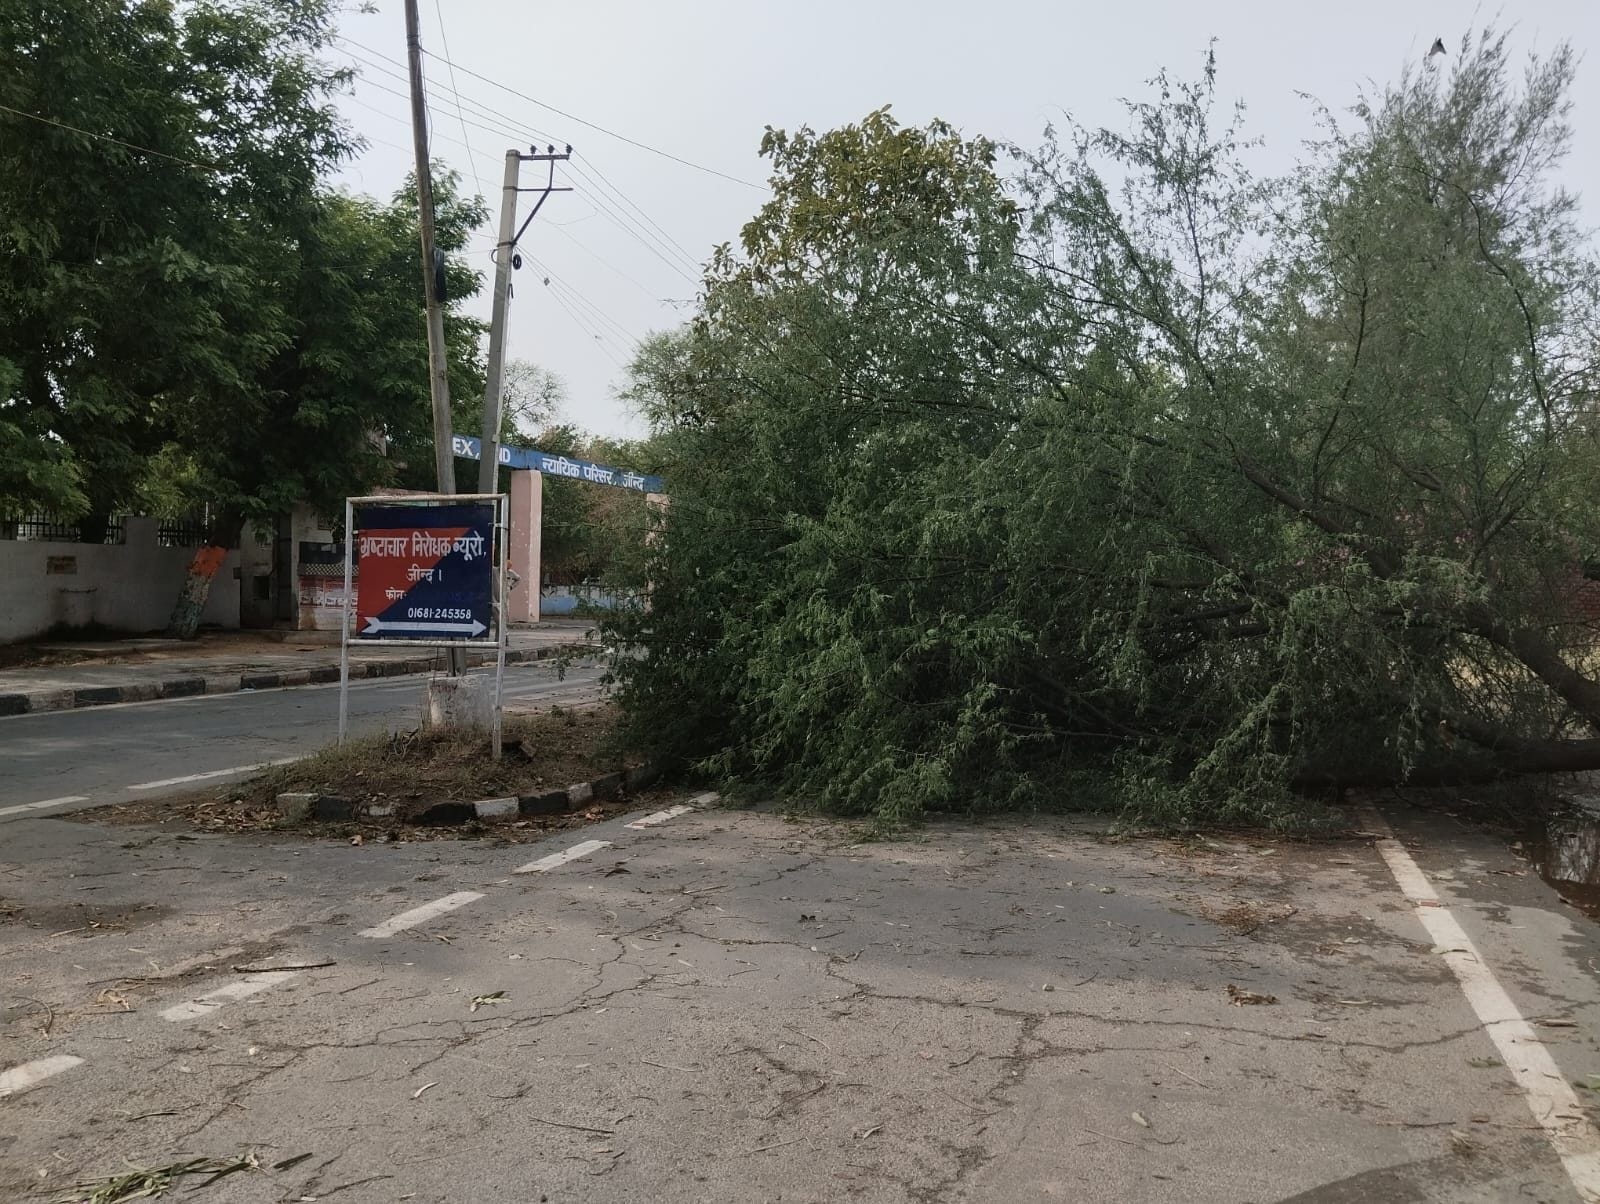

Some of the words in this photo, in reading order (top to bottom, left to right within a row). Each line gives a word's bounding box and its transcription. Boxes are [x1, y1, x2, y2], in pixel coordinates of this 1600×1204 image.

[542, 456, 581, 477] न्यायिक
[622, 472, 645, 491] जीन्द
[360, 536, 409, 558] भ्रष्टाचार
[412, 531, 451, 558] निरोधक
[408, 607, 472, 619] 01681-245358
